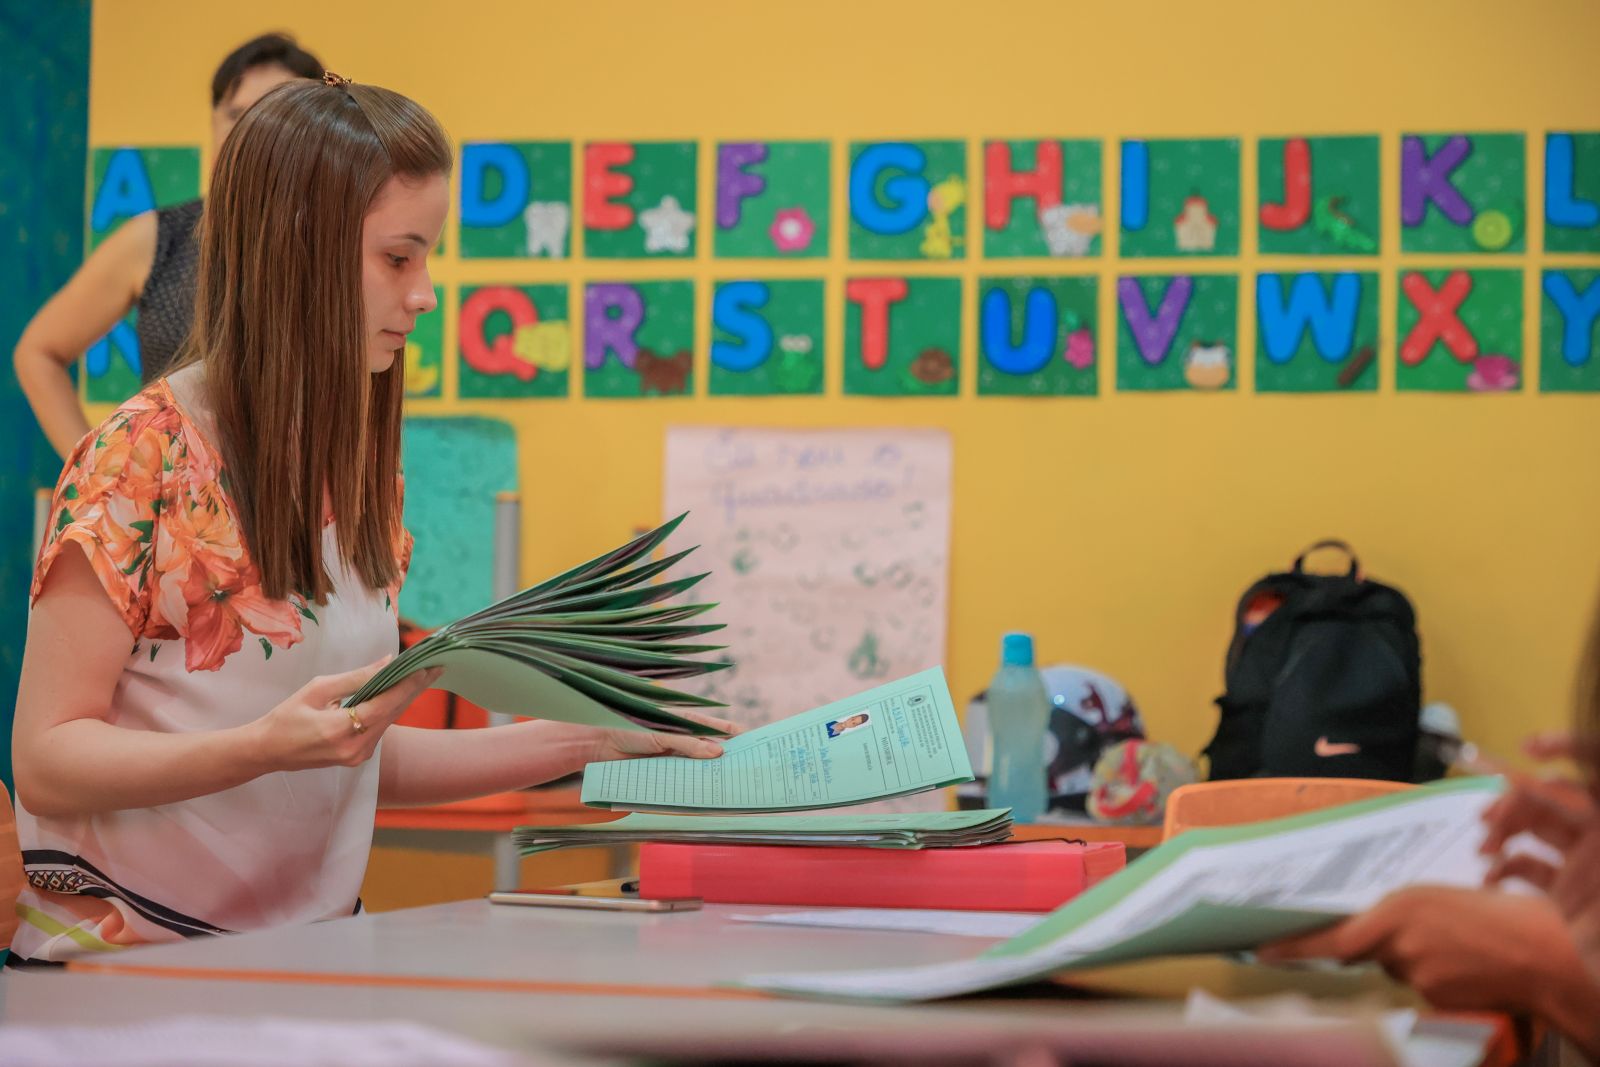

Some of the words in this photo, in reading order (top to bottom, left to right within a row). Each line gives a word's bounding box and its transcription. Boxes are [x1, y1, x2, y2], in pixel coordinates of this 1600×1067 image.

[91, 148, 154, 227] A
[460, 143, 529, 226] D
[583, 143, 635, 229] E
[716, 143, 766, 228] F
[850, 143, 930, 234] G
[985, 140, 1063, 229] H
[1120, 140, 1148, 231] I
[1260, 139, 1310, 229] J
[1401, 136, 1474, 226] K
[1545, 133, 1600, 227] L
[459, 286, 538, 381] Q
[584, 283, 645, 369] R
[710, 281, 772, 370] S
[847, 278, 907, 368] T
[982, 288, 1058, 375] U
[1118, 276, 1193, 363] V
[1256, 272, 1361, 363] W
[1401, 272, 1478, 364] X
[1543, 272, 1600, 366] Y
